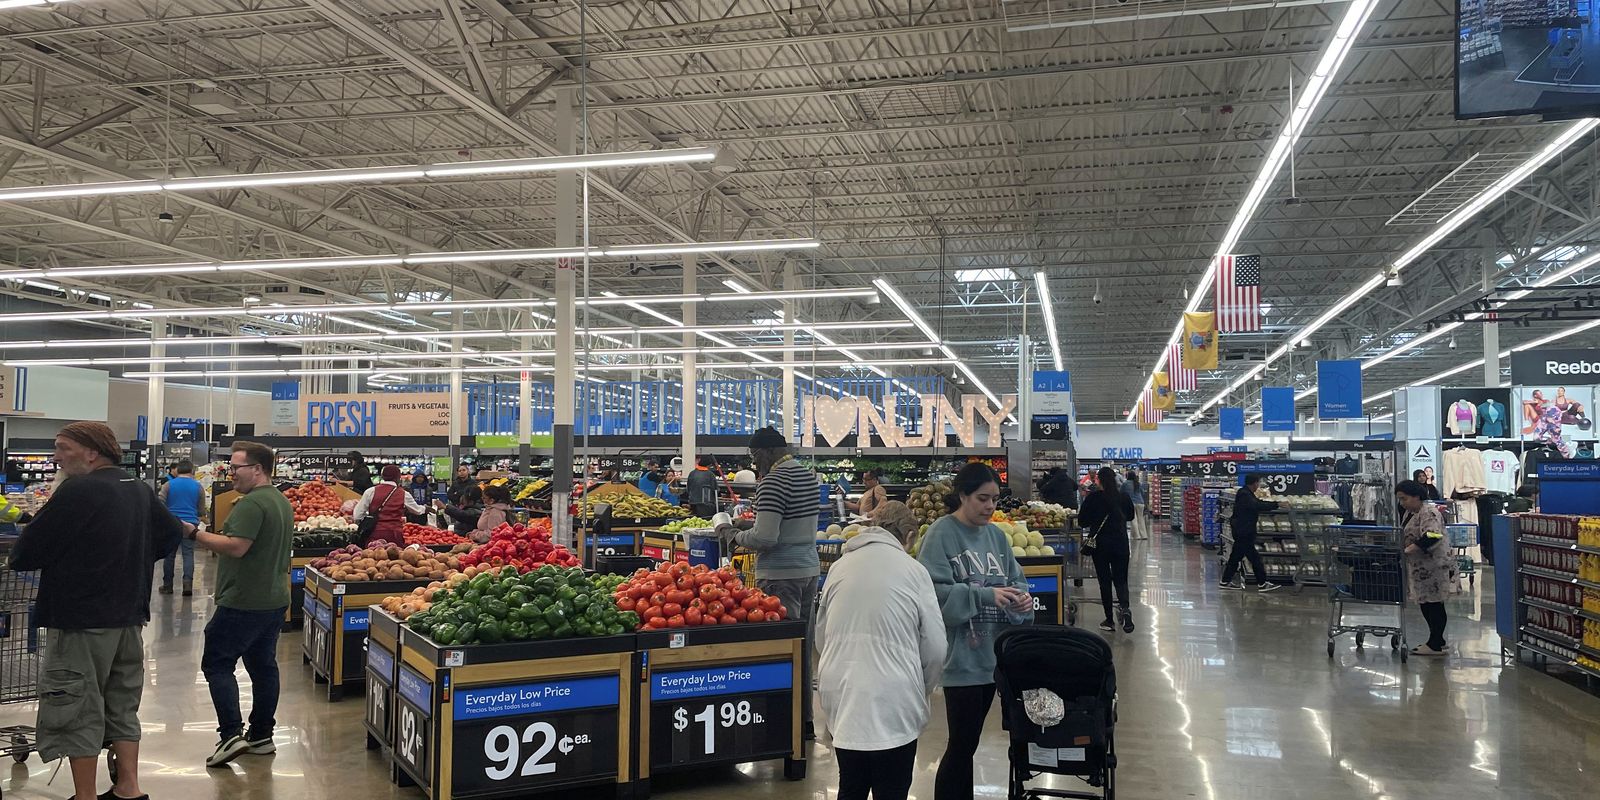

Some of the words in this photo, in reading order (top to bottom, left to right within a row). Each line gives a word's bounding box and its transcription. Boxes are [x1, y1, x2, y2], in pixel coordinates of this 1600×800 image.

[307, 401, 377, 437] FRESH
[1101, 447, 1143, 459] CREAMER
[1543, 464, 1574, 472] Everyday
[1267, 474, 1300, 493] $397
[661, 675, 705, 687] Everyday
[707, 673, 726, 683] Low
[728, 670, 752, 680] Price
[465, 691, 517, 705] Everyday
[520, 689, 541, 700] Low
[544, 686, 571, 698] Price
[465, 706, 487, 714] Precios
[488, 704, 503, 713] bajos
[504, 702, 520, 711] todos
[753, 712, 765, 724] lb.
[483, 721, 574, 781] 92¢
[574, 734, 592, 746] ea.
